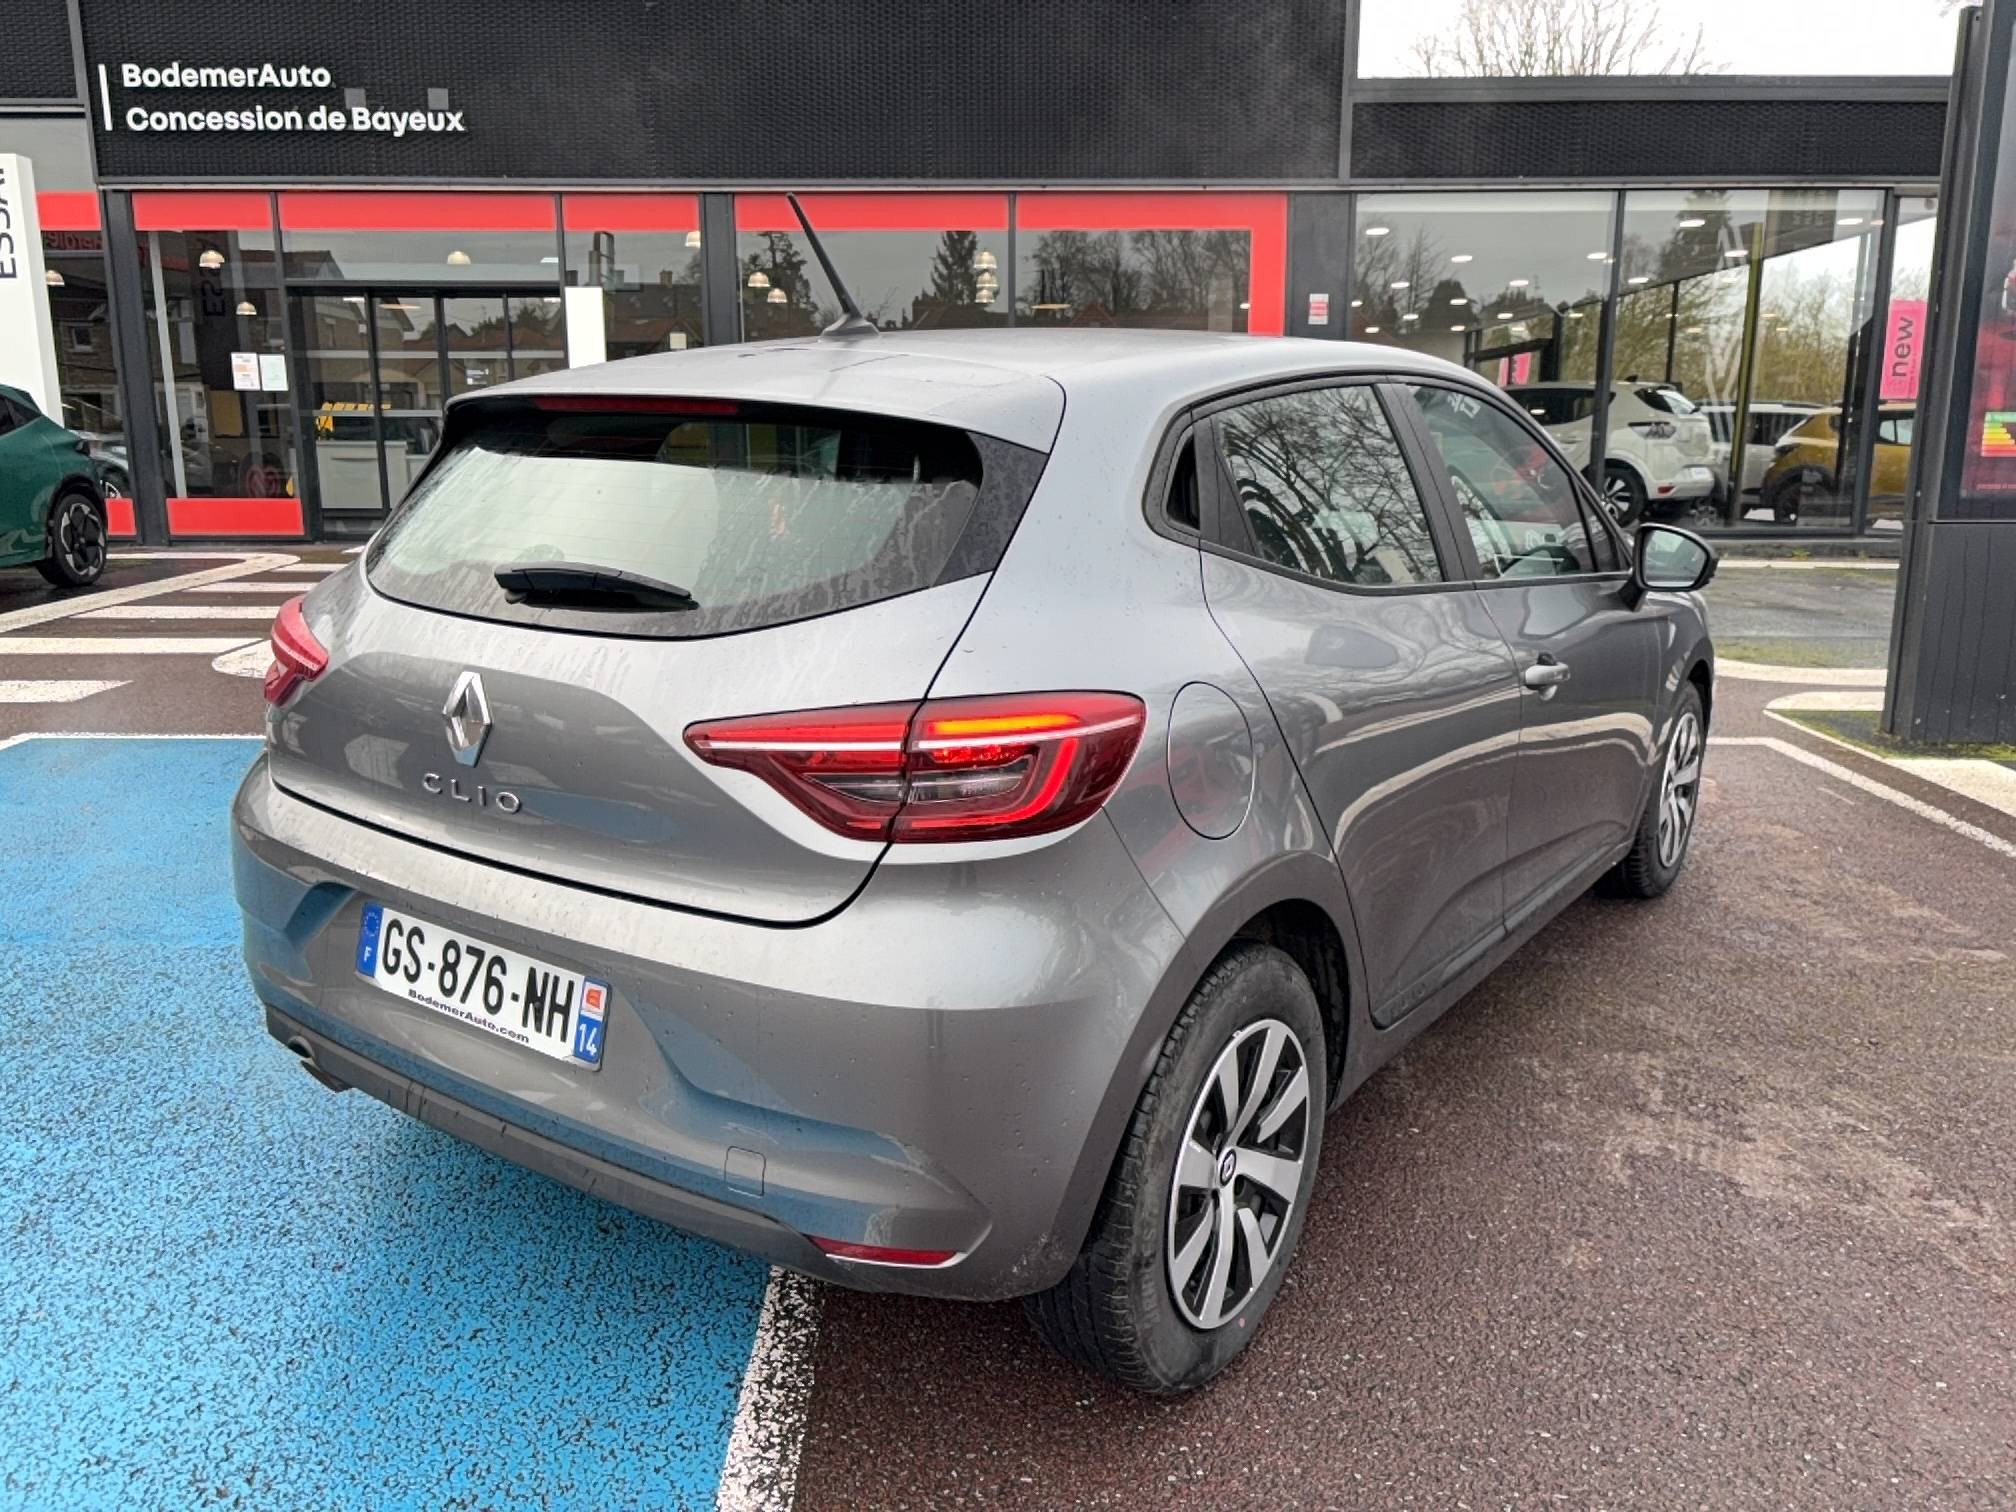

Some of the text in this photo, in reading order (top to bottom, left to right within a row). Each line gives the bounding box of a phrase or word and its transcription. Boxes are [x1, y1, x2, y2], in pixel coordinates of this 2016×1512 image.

[121, 61, 332, 88] BodemerAuto
[126, 104, 465, 137] Concession de Bayeux
[1891, 316, 1914, 377] new
[422, 772, 521, 814] CLIO
[362, 945, 371, 962] F
[382, 918, 575, 1043] GS-876-NH
[407, 988, 530, 1044] BodemerAuto.com
[579, 1022, 598, 1057] 14
